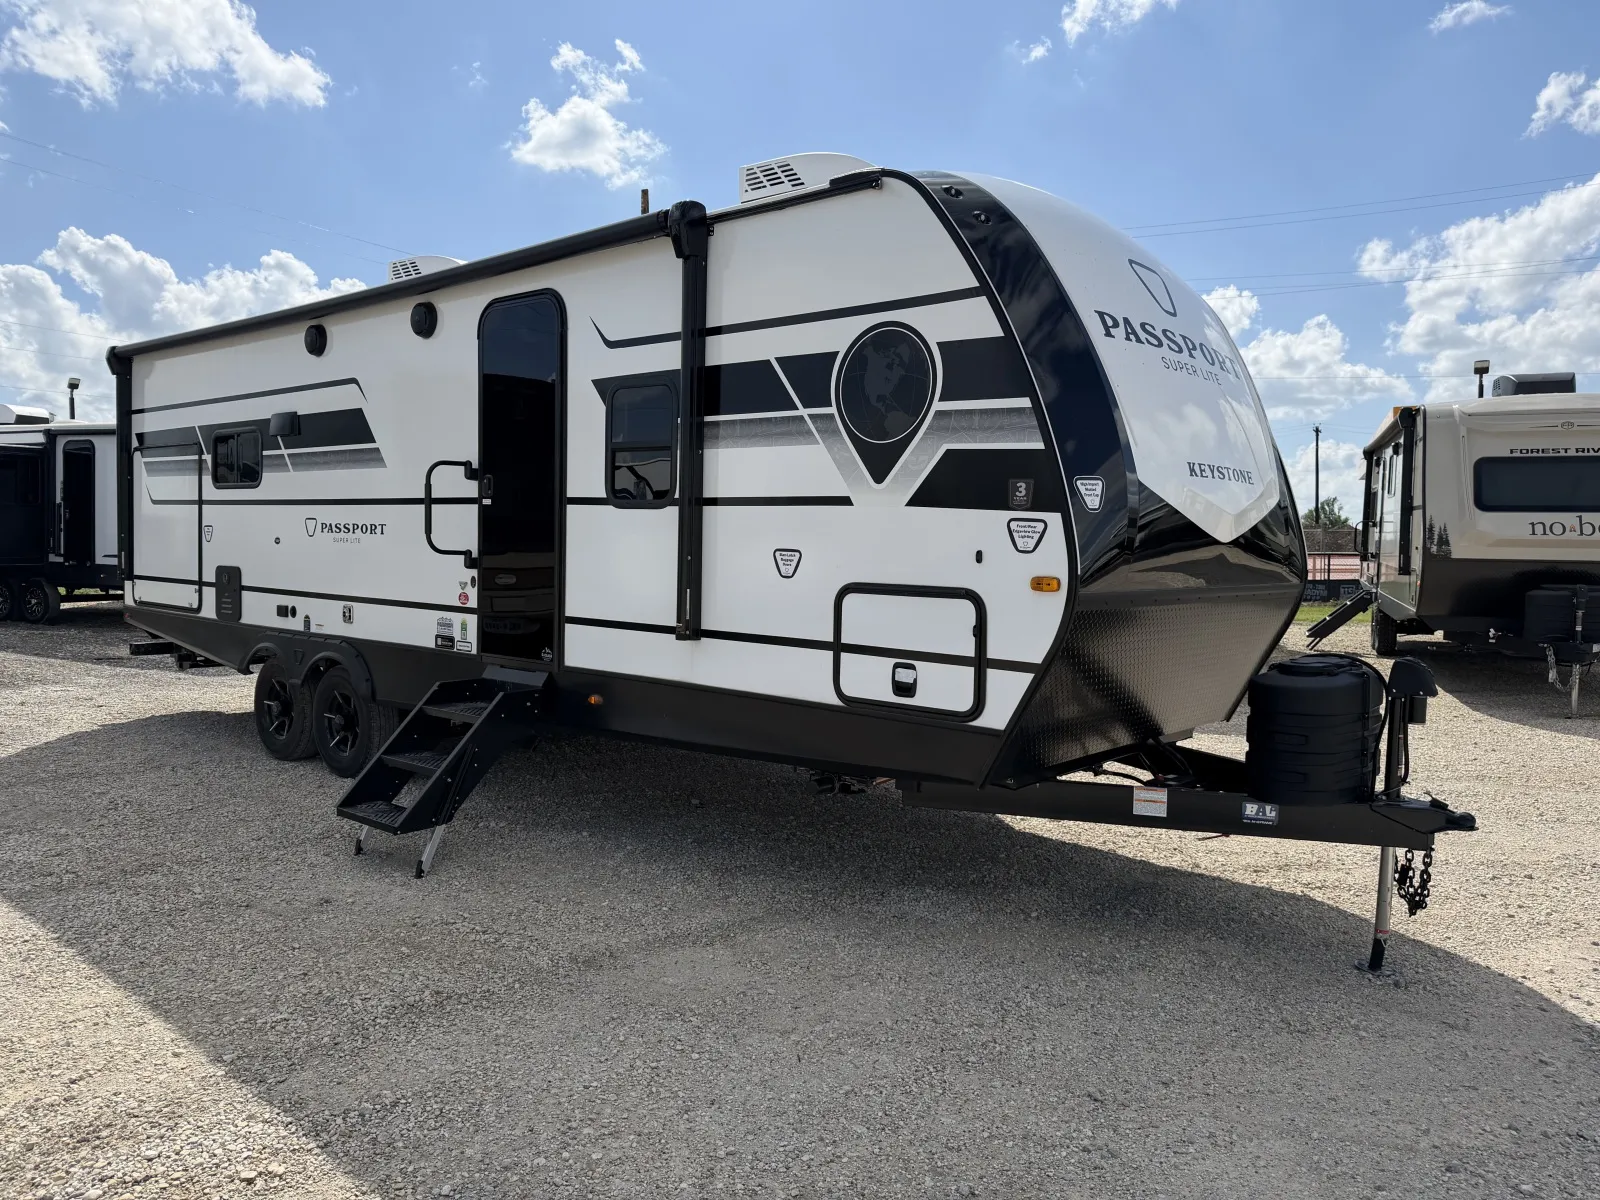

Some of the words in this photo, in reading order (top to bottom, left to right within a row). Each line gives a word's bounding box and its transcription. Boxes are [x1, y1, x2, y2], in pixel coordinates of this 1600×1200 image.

[1094, 310, 1241, 381] PASSPORT
[1162, 357, 1199, 378] SUPER
[1200, 368, 1222, 386] LITE
[1187, 461, 1255, 485] KEYSTONE
[1015, 482, 1026, 497] 3
[320, 522, 387, 535] PASSPORT
[1245, 803, 1277, 817] BAL
